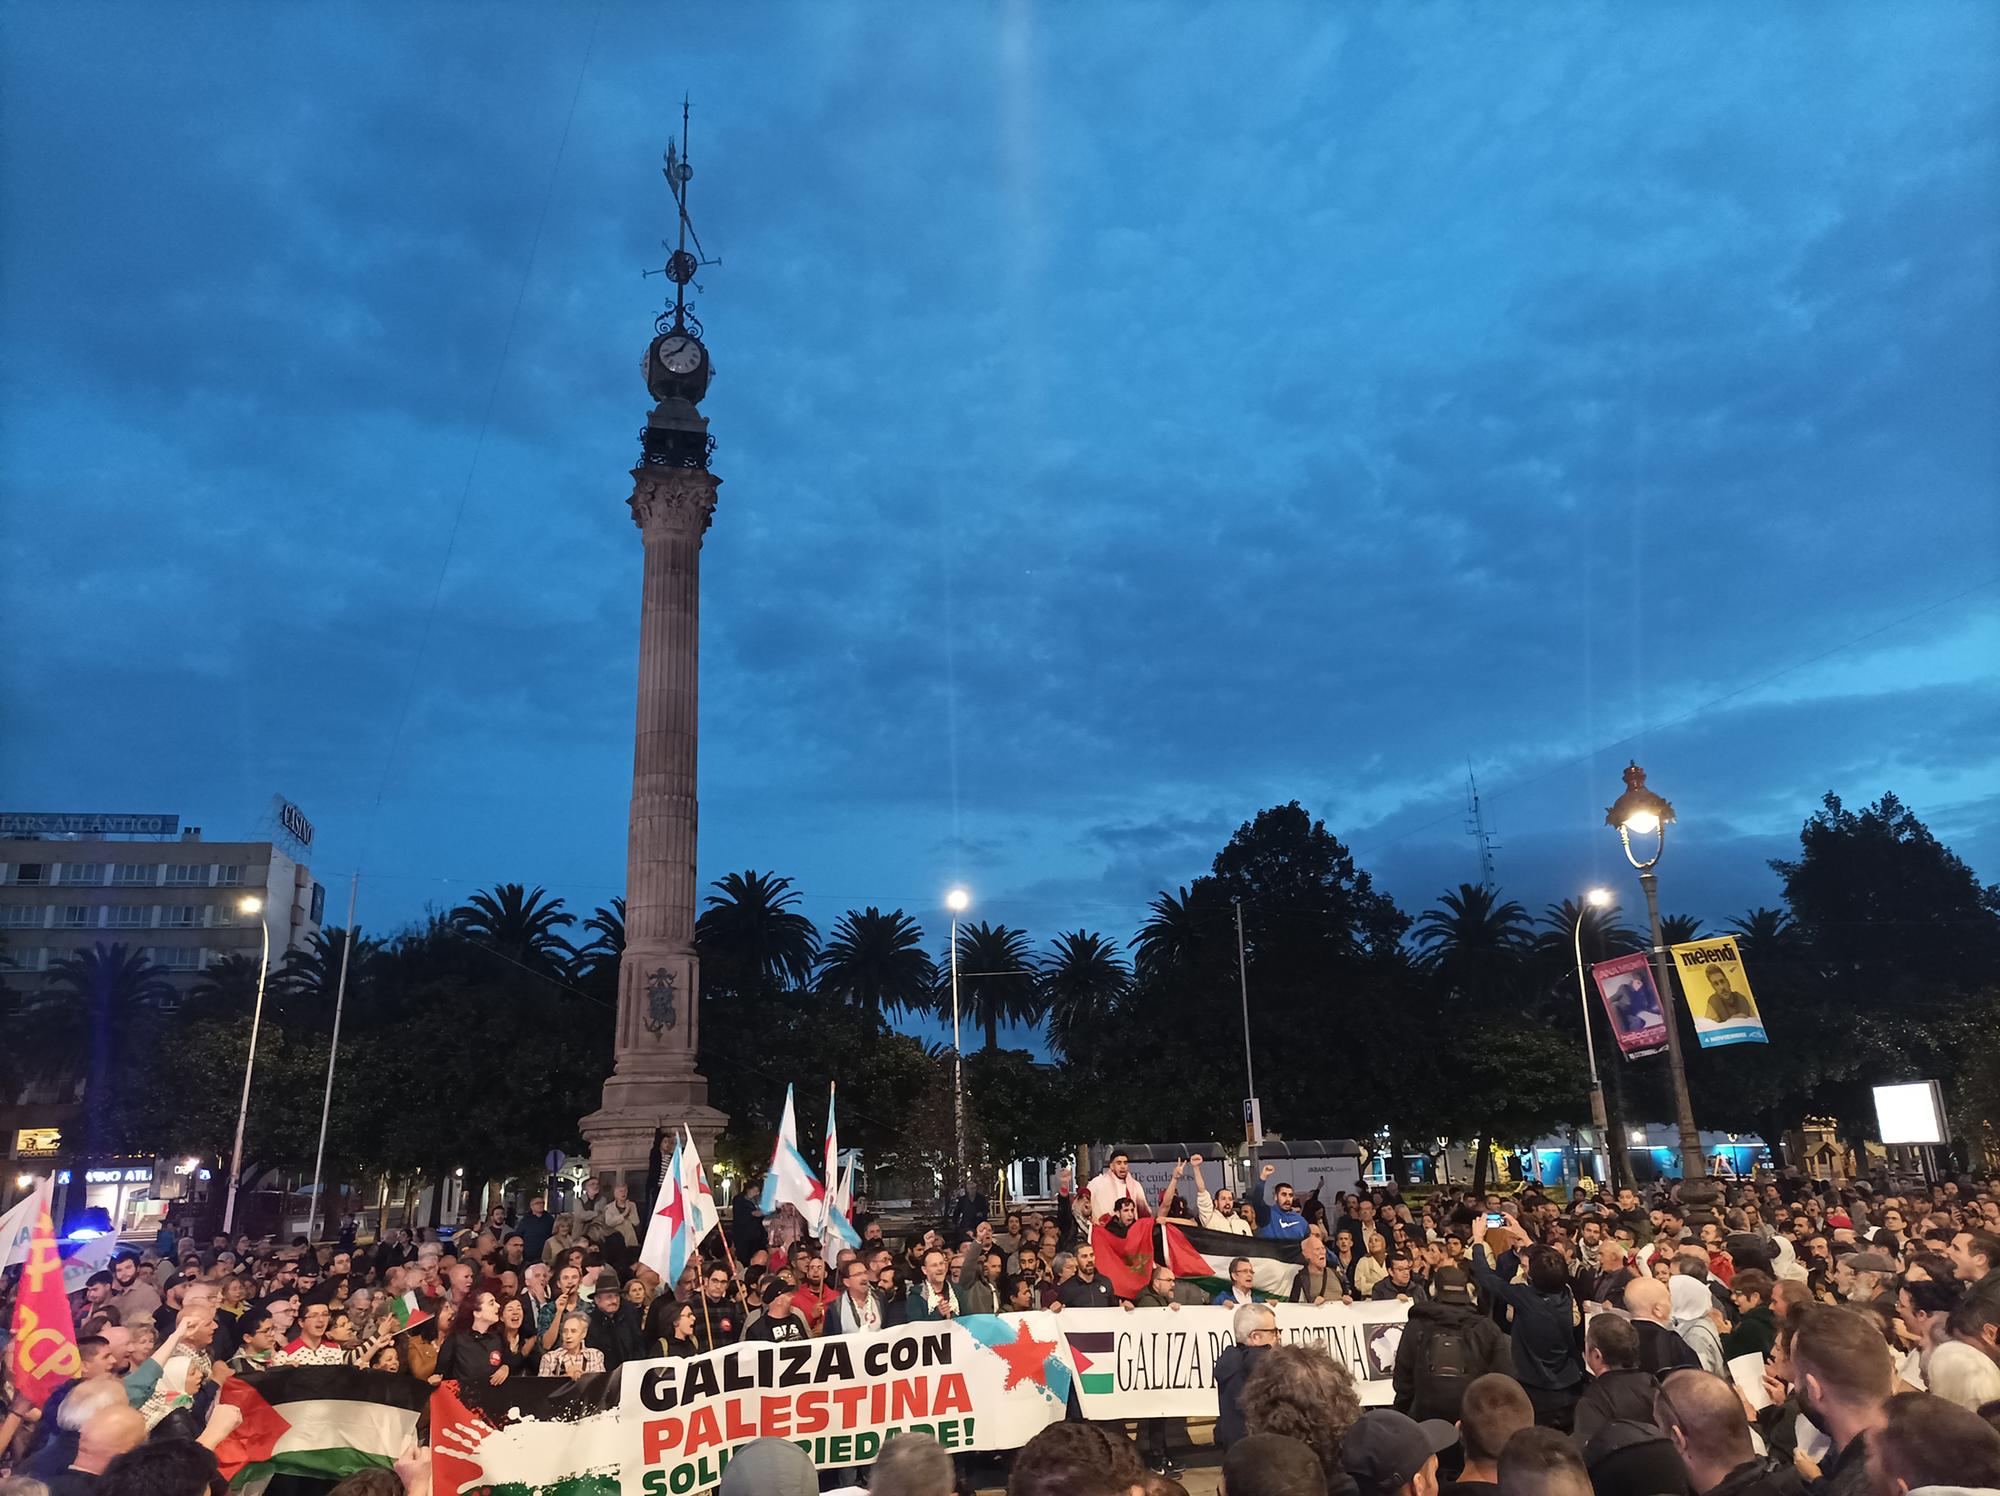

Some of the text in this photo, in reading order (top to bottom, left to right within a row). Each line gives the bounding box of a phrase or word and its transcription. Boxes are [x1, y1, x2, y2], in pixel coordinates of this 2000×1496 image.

[53, 814, 162, 832] ATLÁNTICO
[284, 805, 313, 845] CASINO
[1680, 944, 1737, 966] melendi
[640, 1333, 952, 1413] GALIZA CON
[1116, 1332, 1204, 1392] GALIZA
[643, 1373, 974, 1465] PALESTINA
